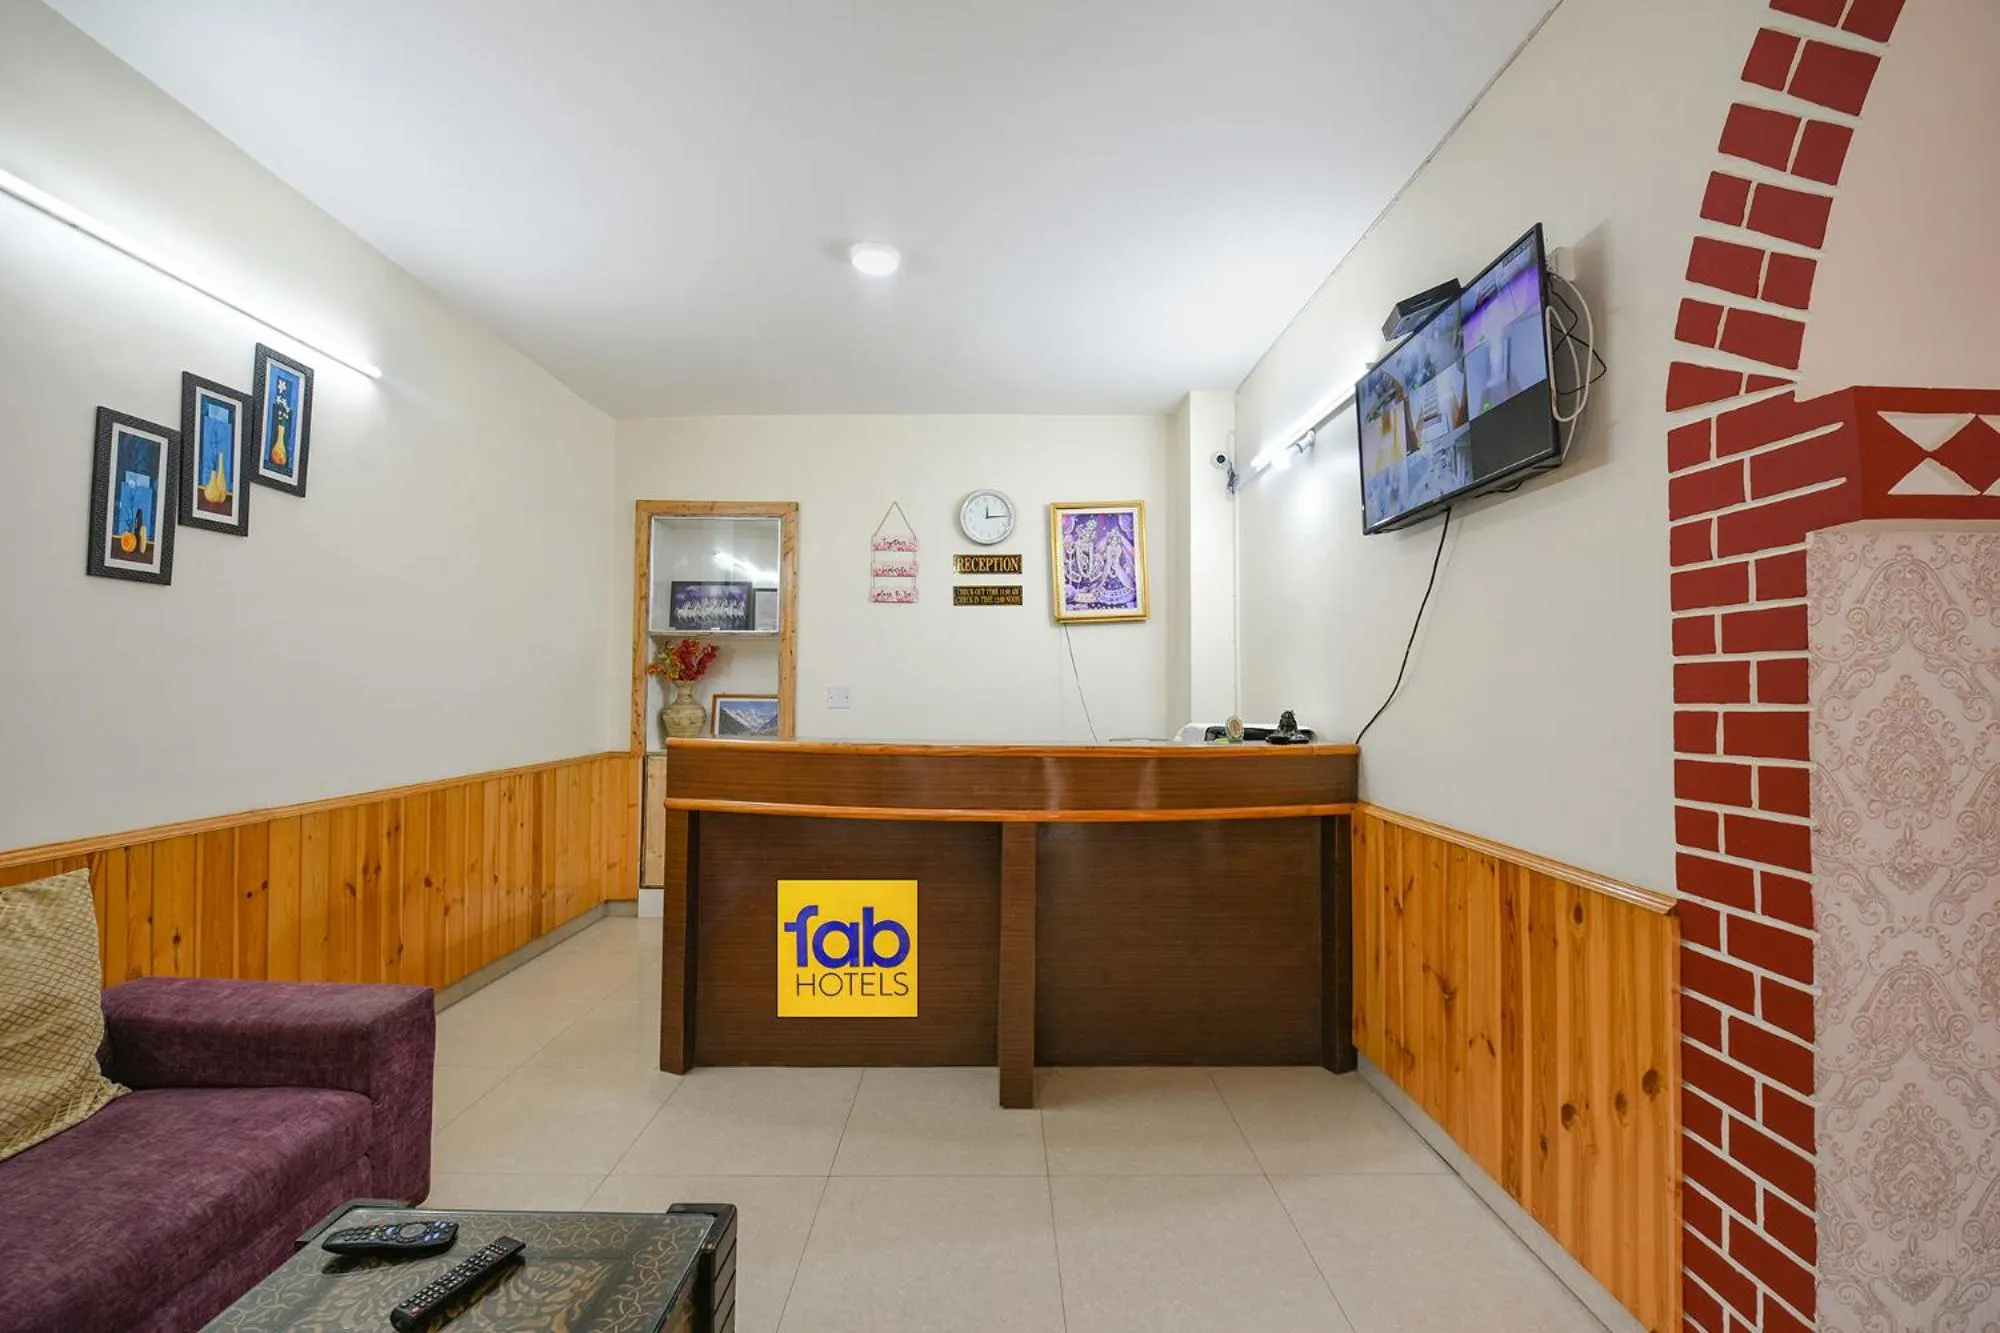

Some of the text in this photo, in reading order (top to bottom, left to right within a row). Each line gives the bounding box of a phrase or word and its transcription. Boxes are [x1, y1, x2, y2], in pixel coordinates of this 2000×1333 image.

[957, 557, 1018, 572] RECEPTION
[784, 905, 910, 969] fab
[796, 972, 909, 997] HOTELS
